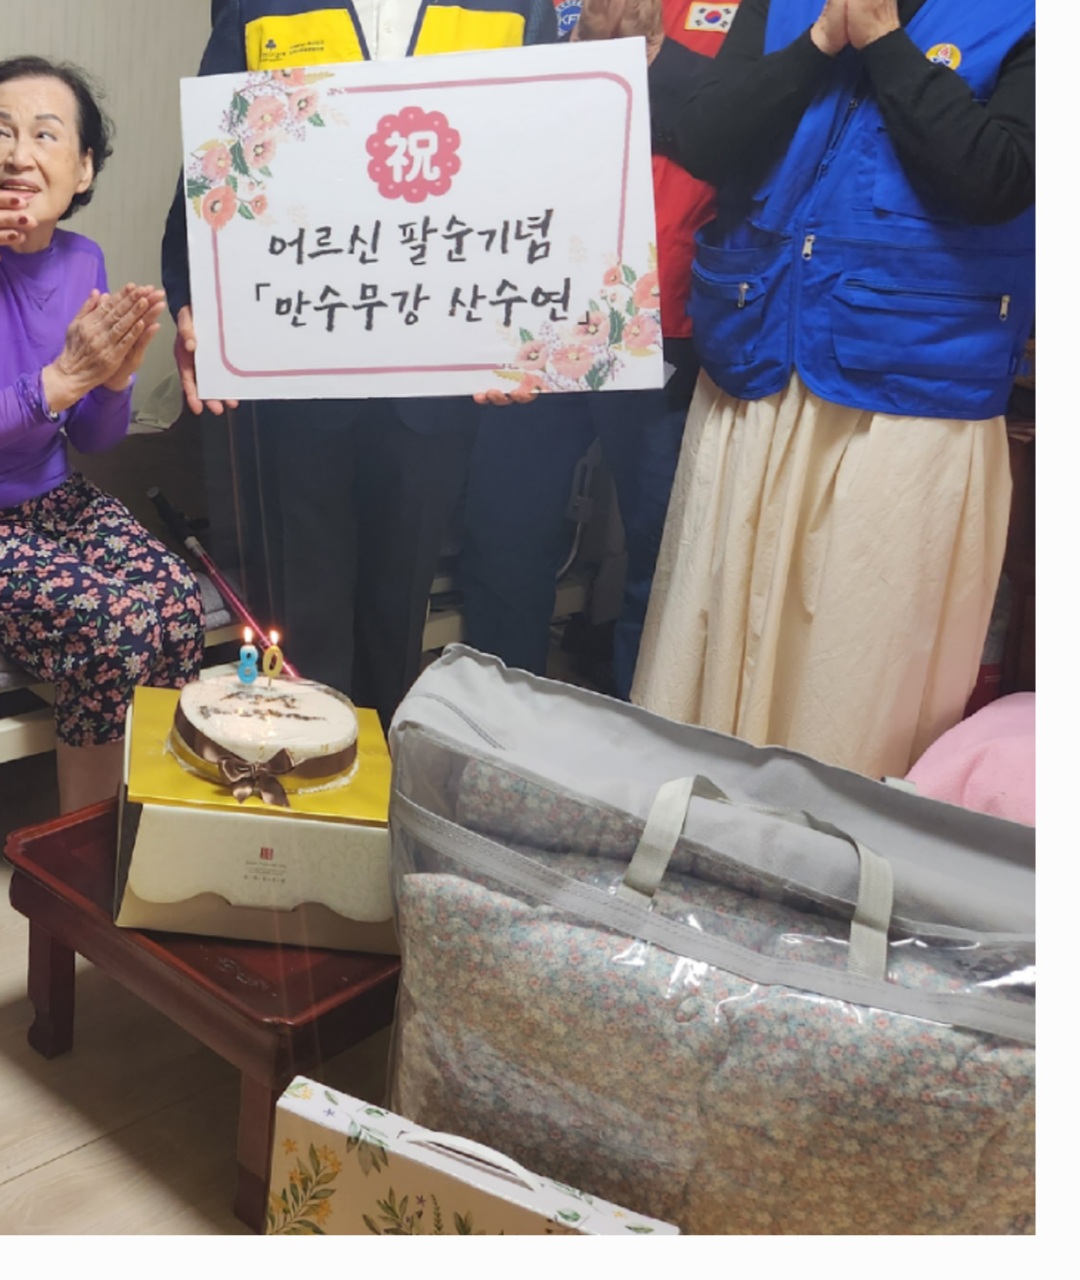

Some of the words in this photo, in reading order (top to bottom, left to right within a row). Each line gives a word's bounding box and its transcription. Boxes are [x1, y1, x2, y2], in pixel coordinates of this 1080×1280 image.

[386, 130, 440, 183] 祝
[269, 220, 381, 264] 어르신
[398, 209, 554, 265] 팔순기념
[256, 283, 430, 332] 「만수무강
[449, 278, 590, 326] 산수연」
